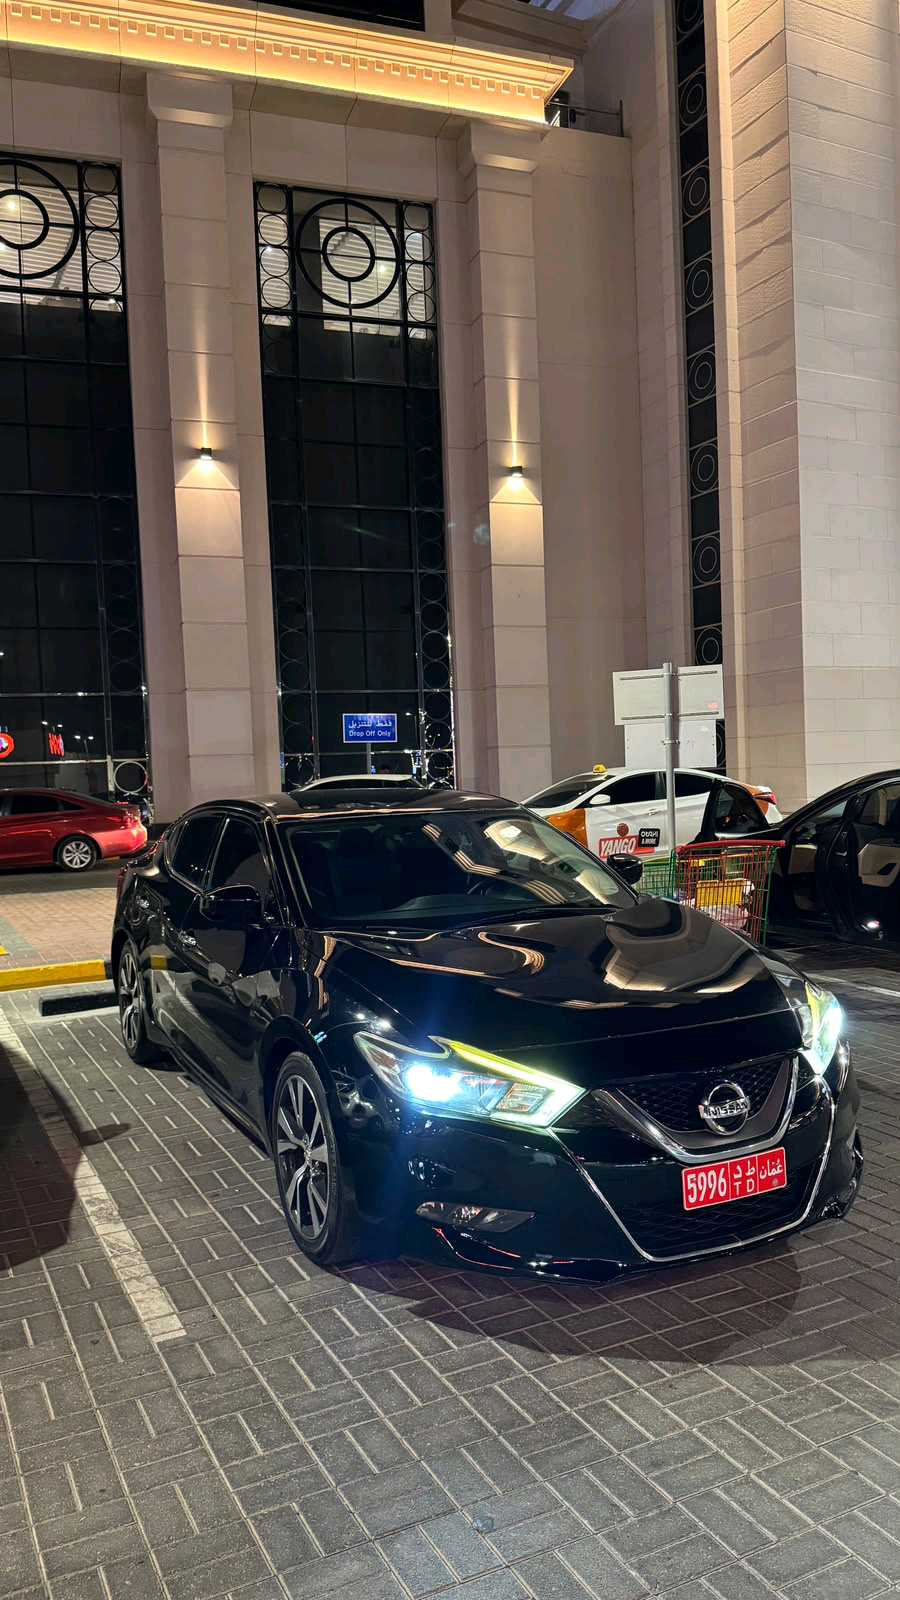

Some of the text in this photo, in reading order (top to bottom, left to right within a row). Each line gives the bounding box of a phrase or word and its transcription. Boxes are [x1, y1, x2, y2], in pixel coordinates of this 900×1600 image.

[600, 838, 636, 857] YANGO
[698, 1098, 750, 1119] NISSAN
[687, 1168, 727, 1203] 5996
